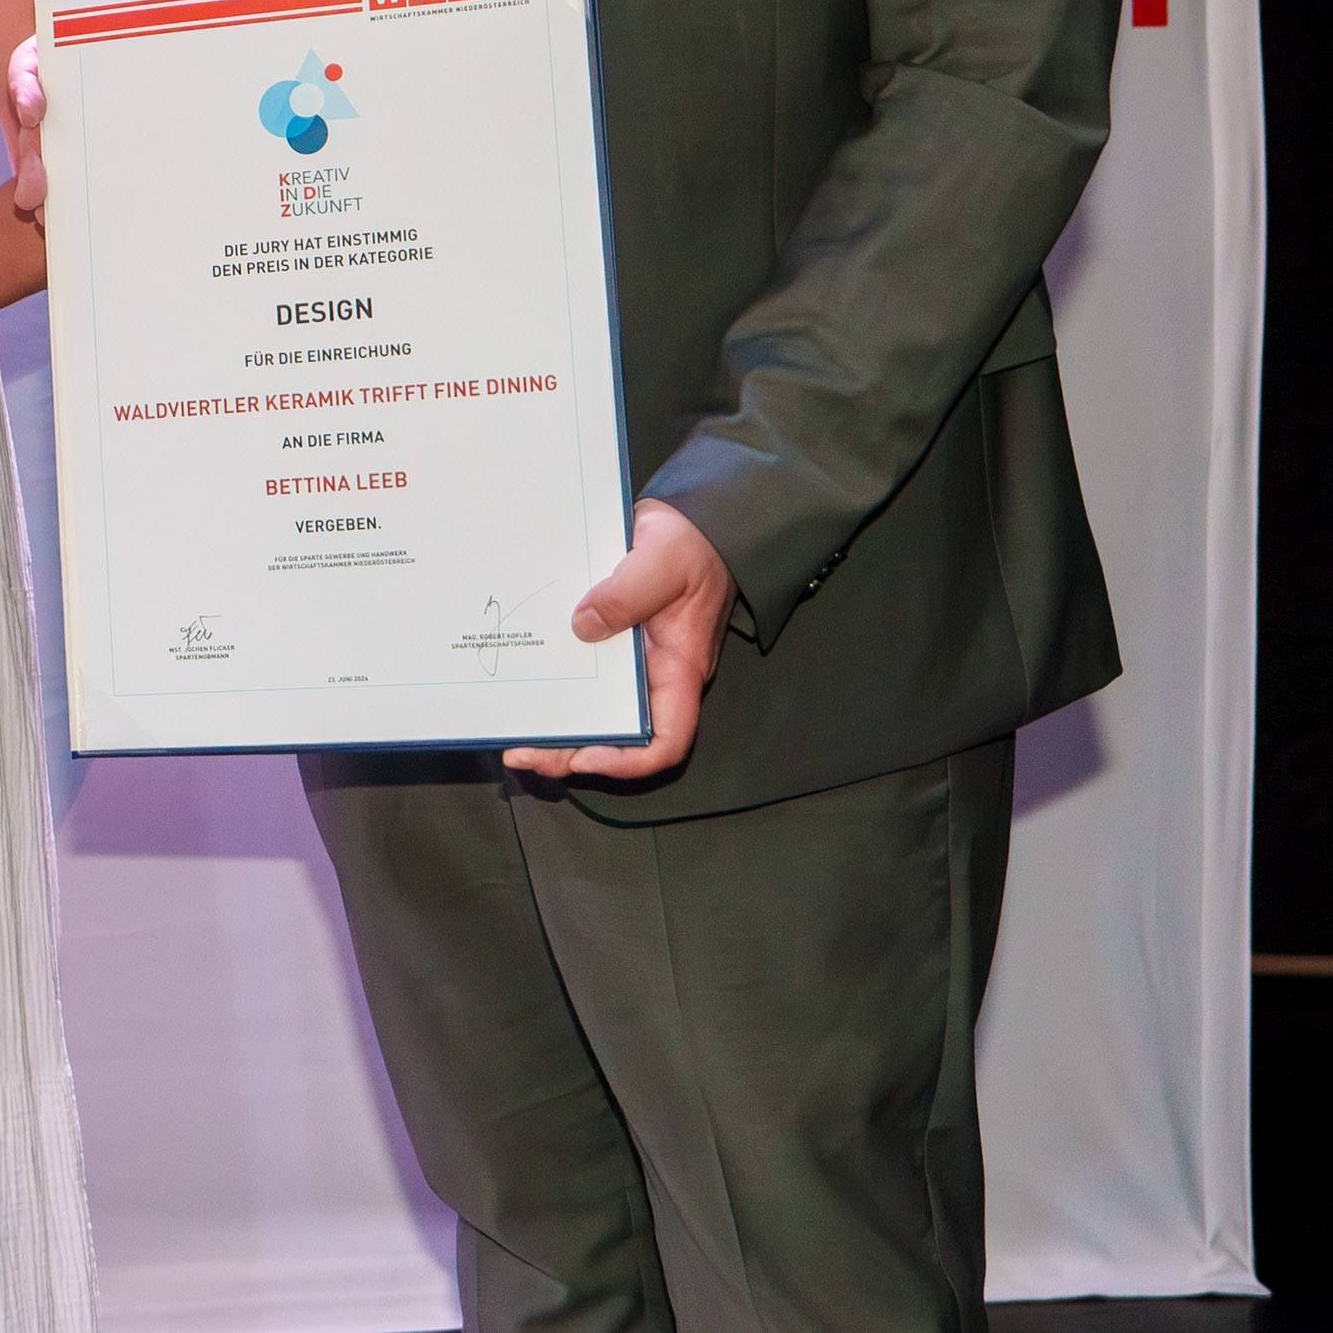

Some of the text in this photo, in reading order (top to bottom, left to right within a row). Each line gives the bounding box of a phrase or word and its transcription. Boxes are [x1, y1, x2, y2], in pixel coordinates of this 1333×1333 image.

[370, 7, 454, 22] WIRTSCHAFTSKAMMER
[278, 167, 351, 187] KREATIV
[279, 184, 333, 203] IN DIE
[280, 196, 363, 218] ZUKUNFT
[224, 228, 419, 258] DIE JURY HAT EINSTIMMIG
[212, 246, 435, 278] DEN PREIS IN DER KATEGORIE
[276, 297, 374, 326] DESIGN
[244, 342, 413, 368] FÜR DIE EINREICHUNG
[113, 373, 559, 422] WALDVIERTLER KERAMIK TRIFFT FINE DINING
[282, 430, 385, 450] AN DIE FIRMA
[265, 471, 409, 497] BETTINA LEEB
[295, 516, 383, 534] VERGEBEN.
